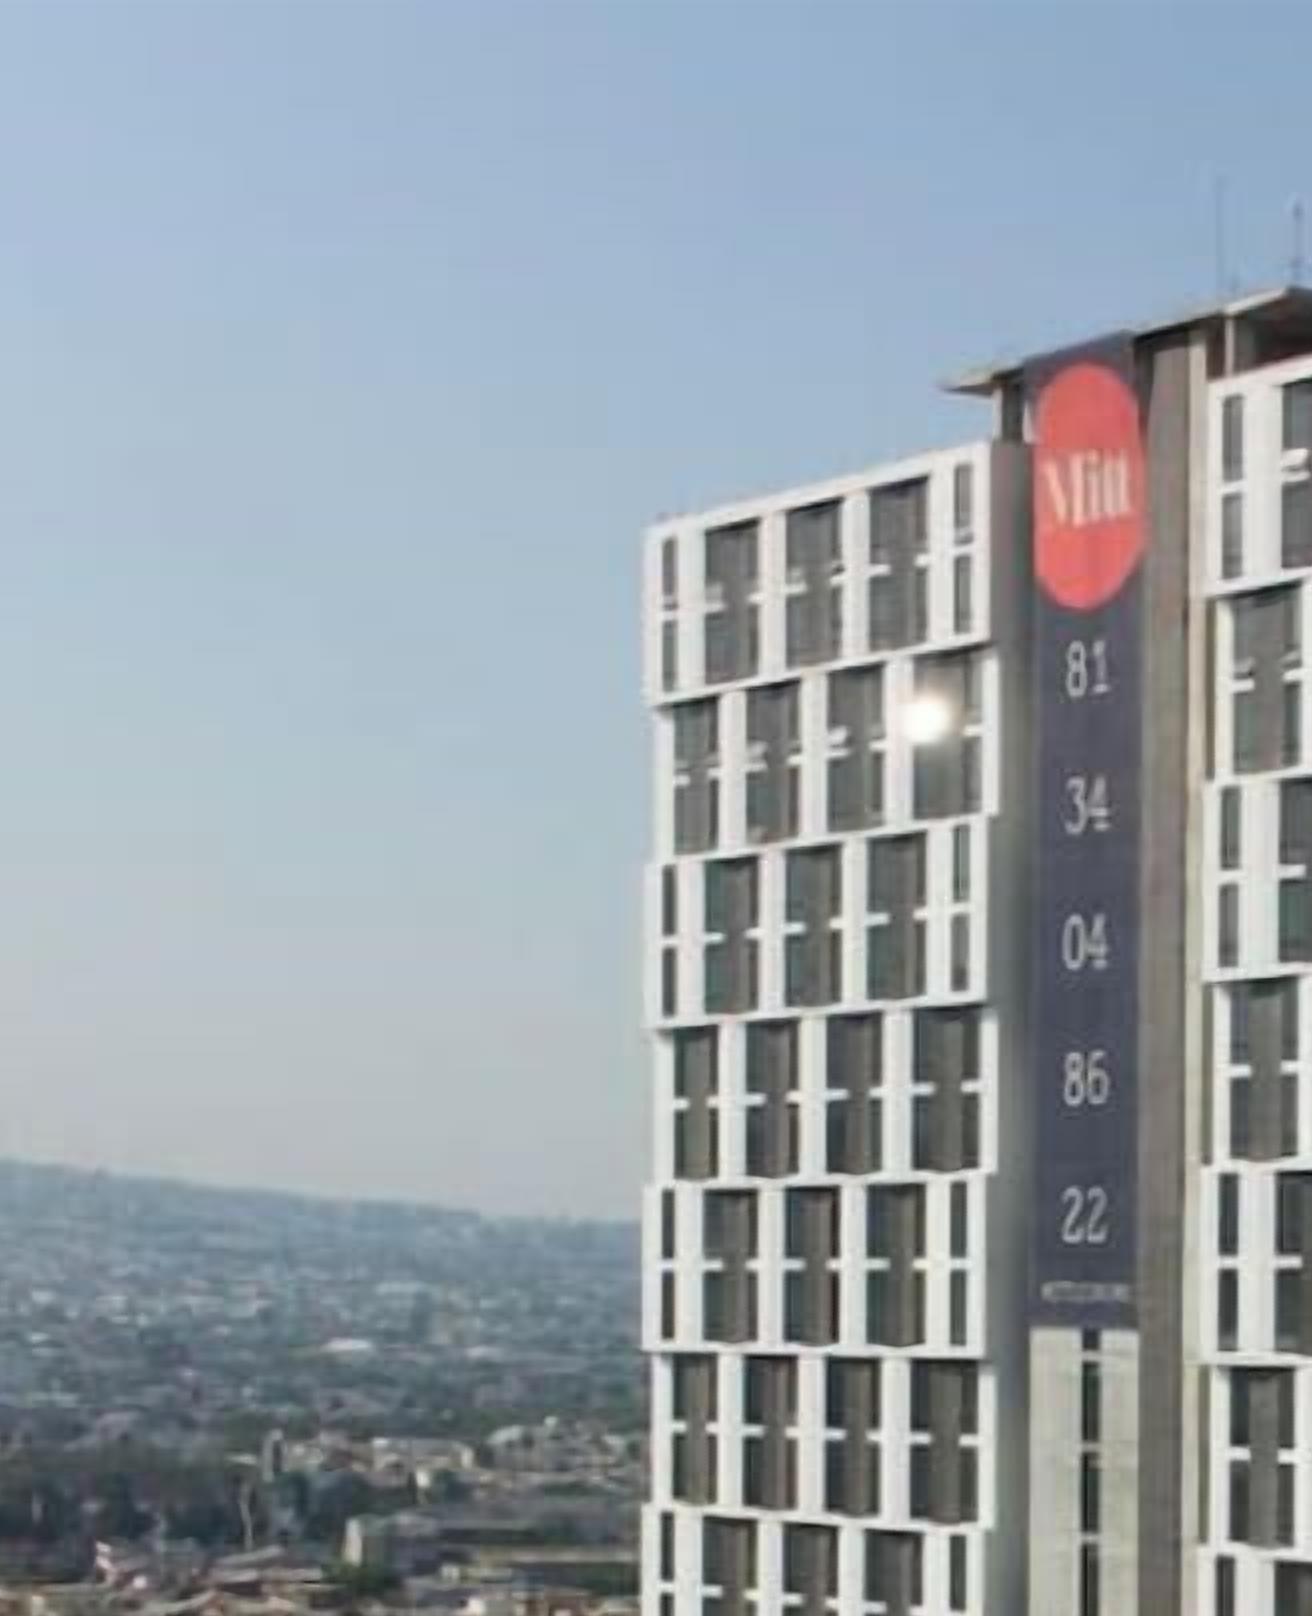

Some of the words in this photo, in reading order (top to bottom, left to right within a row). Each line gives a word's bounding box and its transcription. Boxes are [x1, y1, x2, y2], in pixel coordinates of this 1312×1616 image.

[1065, 640, 1110, 697] 81
[1064, 775, 1110, 834] 34
[1062, 913, 1111, 971] 04
[1063, 1049, 1112, 1107] 86
[1062, 1186, 1111, 1244] 22
